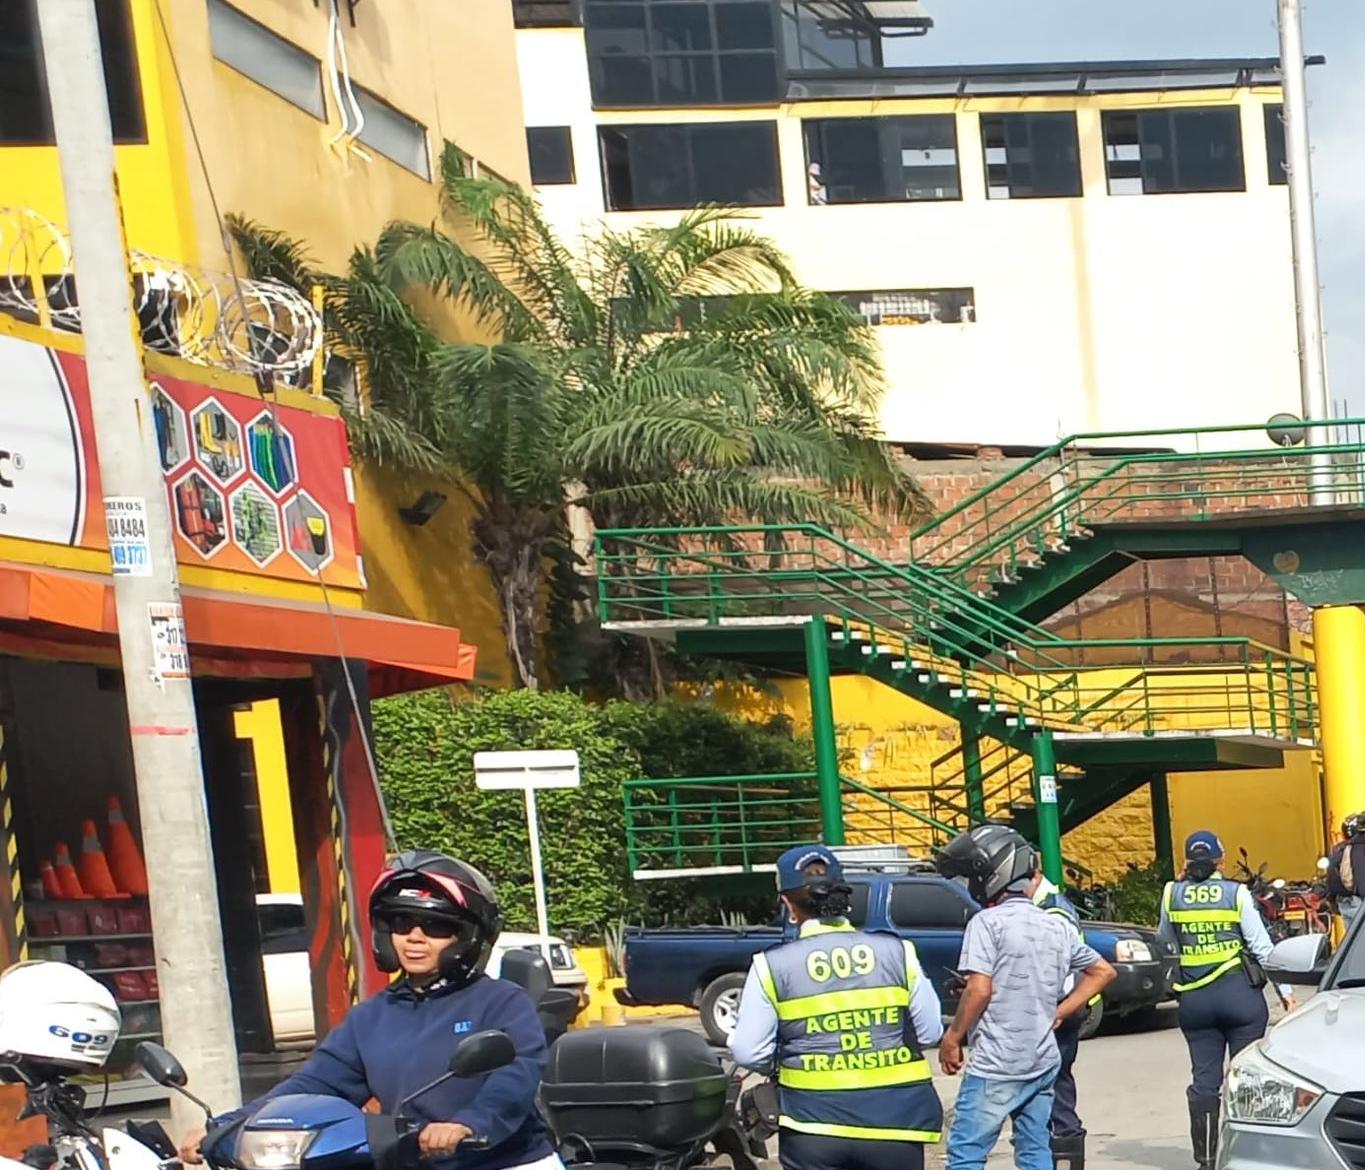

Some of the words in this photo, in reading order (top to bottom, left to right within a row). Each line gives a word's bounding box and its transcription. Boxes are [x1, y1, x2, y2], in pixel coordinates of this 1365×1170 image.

[1183, 885, 1222, 904] 569
[1181, 921, 1232, 933] AGENTE
[1182, 940, 1242, 956] TRANSITO
[1197, 933, 1216, 945] DE
[806, 943, 876, 982] 609
[806, 1006, 899, 1034] AGENTE
[48, 1025, 108, 1045] 609
[840, 1031, 873, 1052] DE
[801, 1046, 912, 1072] TRANSITO
